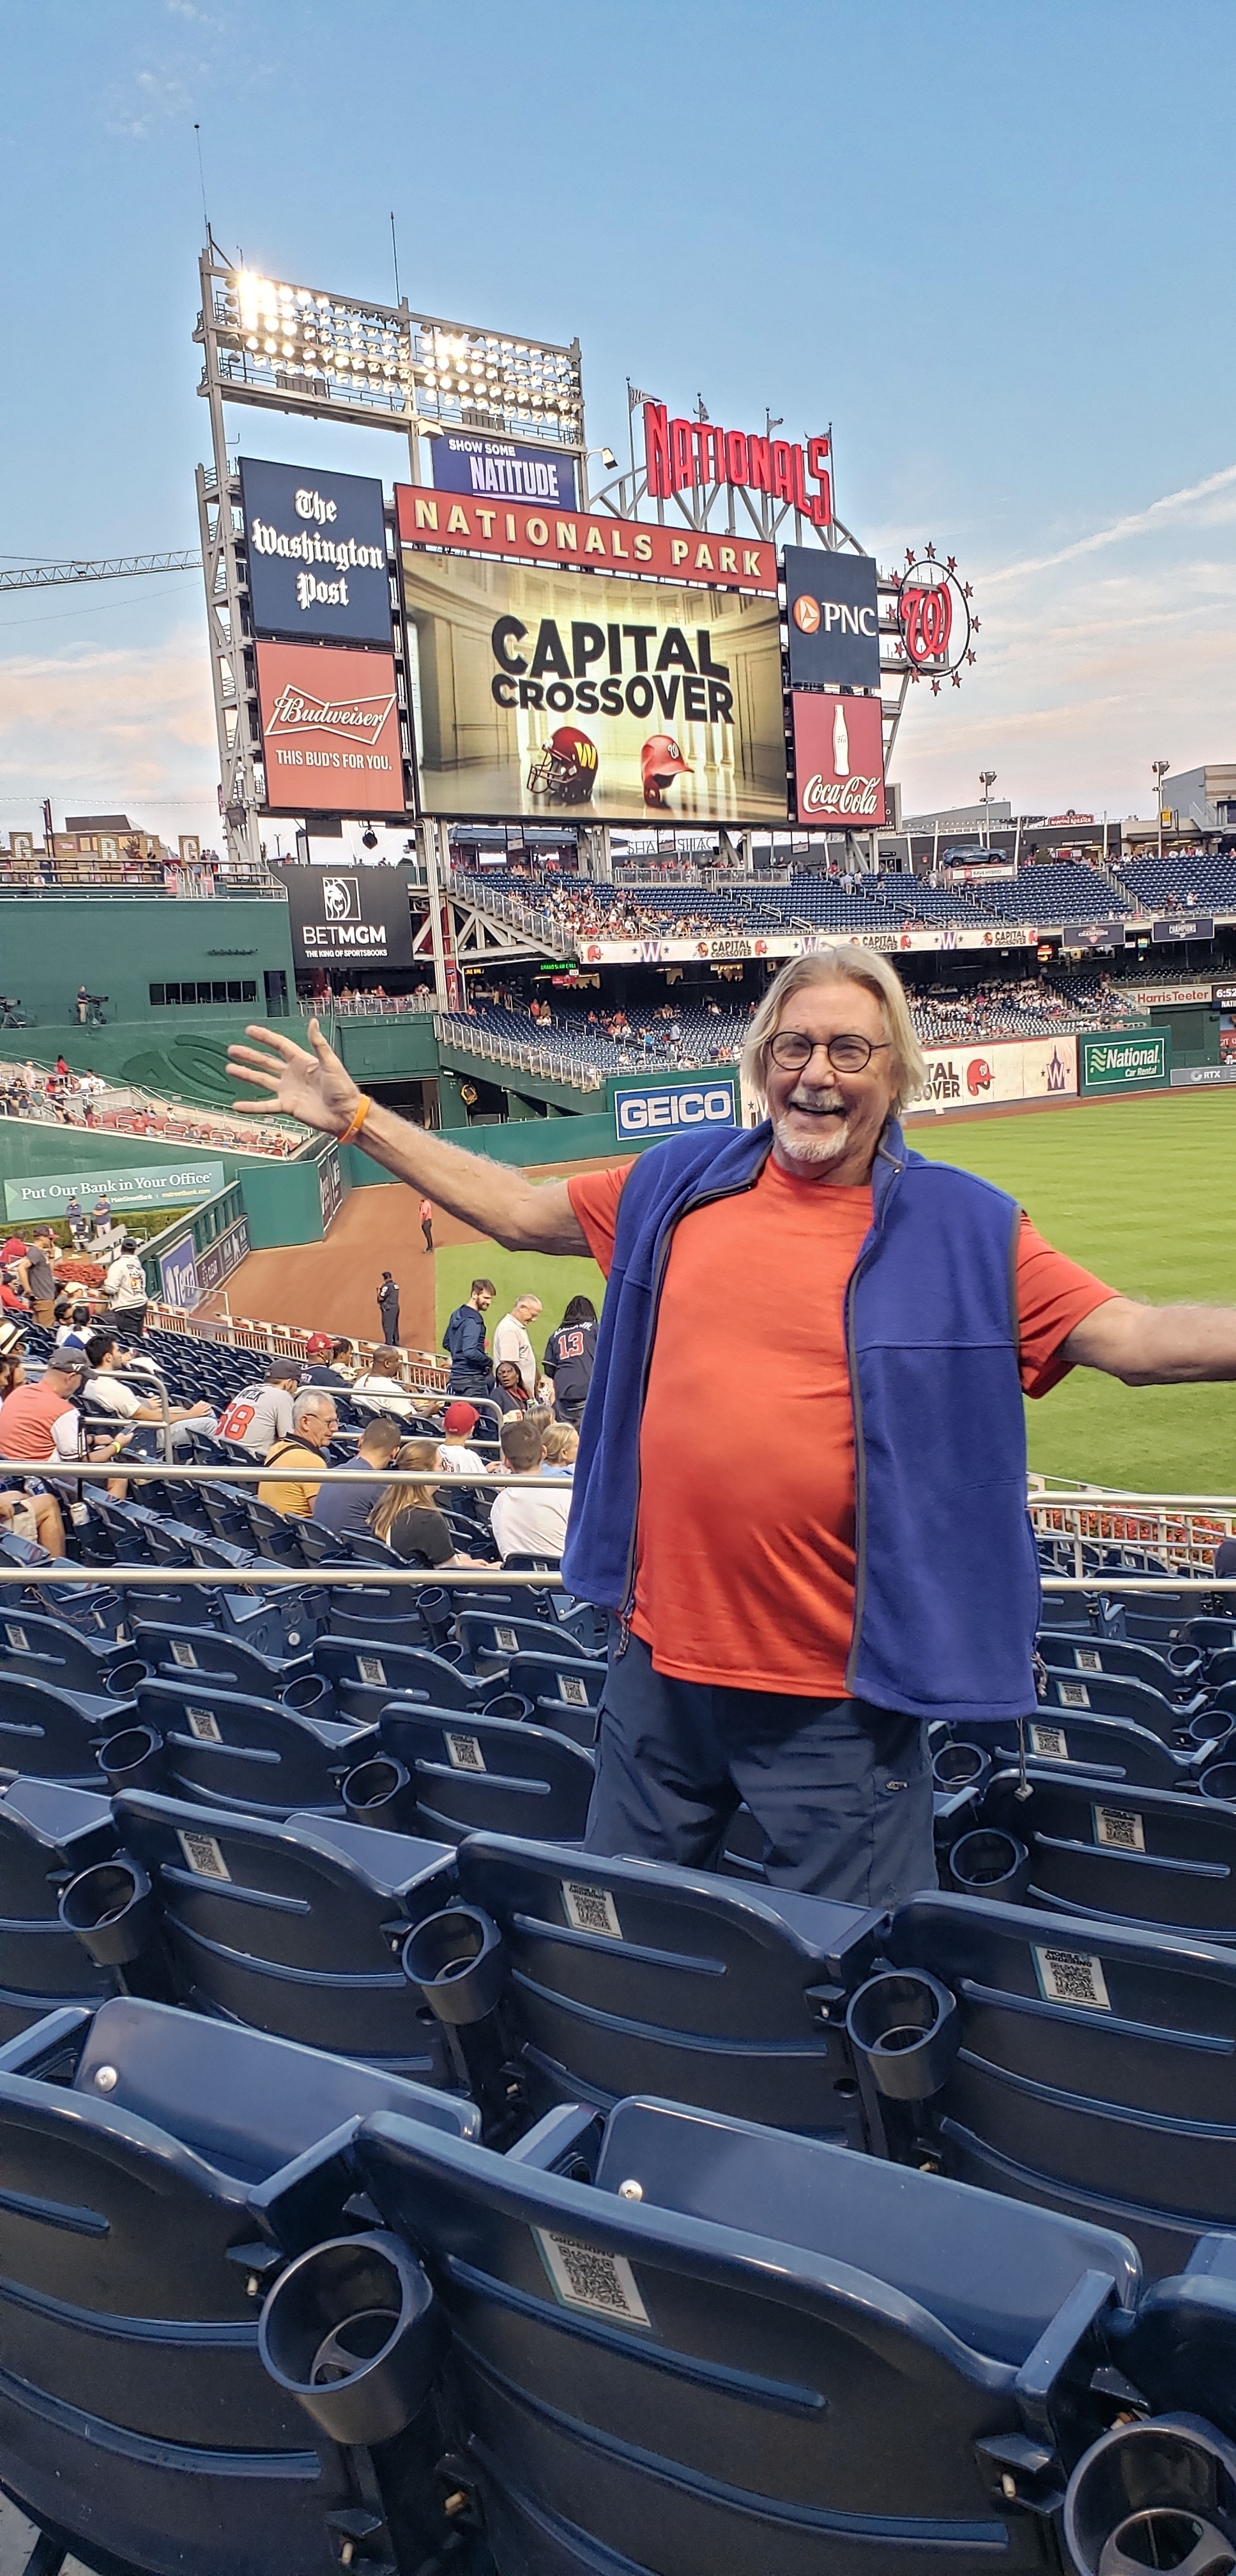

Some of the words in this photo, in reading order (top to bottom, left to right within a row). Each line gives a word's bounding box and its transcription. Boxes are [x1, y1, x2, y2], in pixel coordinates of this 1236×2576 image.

[448, 439, 483, 454] SHOW
[485, 443, 516, 457] SOME
[644, 402, 831, 526] NATIONALS
[469, 456, 560, 498] NATITUDE
[295, 489, 337, 525] The
[252, 518, 385, 571] Washington
[415, 499, 652, 561] NATIONALS
[672, 540, 761, 577] PARK
[296, 572, 349, 610] Post
[821, 602, 877, 637] PNC
[491, 615, 729, 684] CAPITAL
[491, 673, 735, 725] CROSSOVER
[273, 696, 385, 727] Budweiser
[276, 749, 303, 765] THIS
[305, 752, 340, 767] BUD'S
[342, 753, 364, 769] FOR
[366, 755, 392, 770] YOU.
[802, 774, 881, 815] Coca-Cola
[676, 836, 717, 852] SHAC
[303, 926, 387, 946] BETMGM
[712, 940, 752, 952] CAPITAL
[862, 935, 898, 946] CAPITAL
[995, 930, 1026, 941] CAPITAL
[995, 938, 1026, 946] CROSSOVER
[319, 949, 334, 958] KING
[344, 949, 388, 958] SPORTSBOOKS
[710, 948, 752, 958] CROSSOVER
[1138, 992, 1171, 1003] Harris
[1172, 990, 1209, 1001] Teeter
[1125, 1068, 1137, 1078] Car
[1137, 1066, 1157, 1076] Rental
[1204, 1070, 1221, 1078] RTX
[620, 1090, 731, 1130] GEICO
[21, 1185, 47, 1201] Put
[49, 1184, 78, 1197] Our
[80, 1179, 117, 1195] Bank
[119, 1178, 133, 1190] in
[133, 1176, 167, 1190] Your
[111, 1194, 153, 1203] MainStreetBank
[162, 1189, 211, 1198] mstreetbank.com
[558, 1331, 584, 1360] 13
[1045, 1955, 1092, 1967] ORDERING
[549, 2234, 615, 2258] ORDERING
